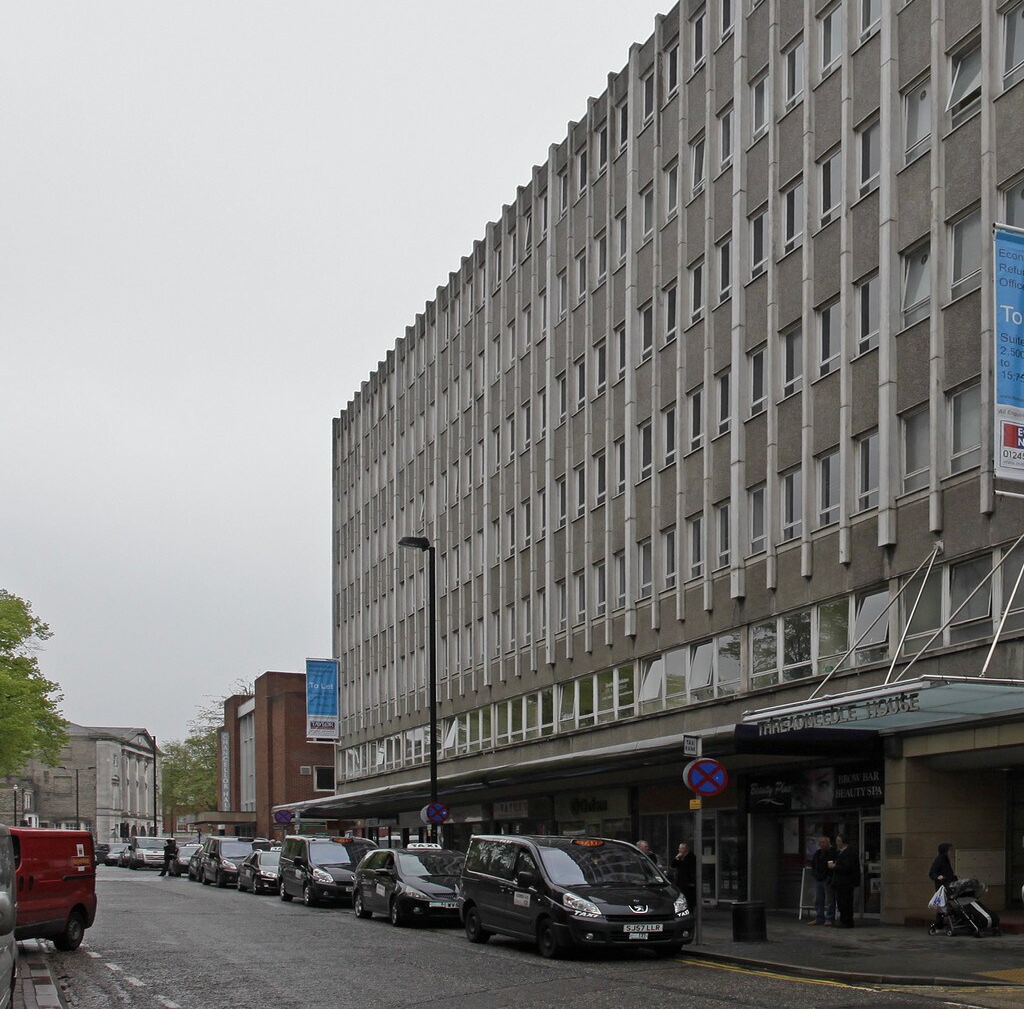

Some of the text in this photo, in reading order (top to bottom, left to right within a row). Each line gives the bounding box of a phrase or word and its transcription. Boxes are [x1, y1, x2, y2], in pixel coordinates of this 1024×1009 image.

[1000, 305, 1023, 325] To
[1000, 359, 1010, 368] to
[309, 681, 319, 690] To
[757, 692, 920, 737] THREADNEEDLE HOUSE
[838, 771, 880, 784] BROW BAR
[835, 785, 883, 798] BEAUTY SPA
[574, 910, 599, 918] TAXI
